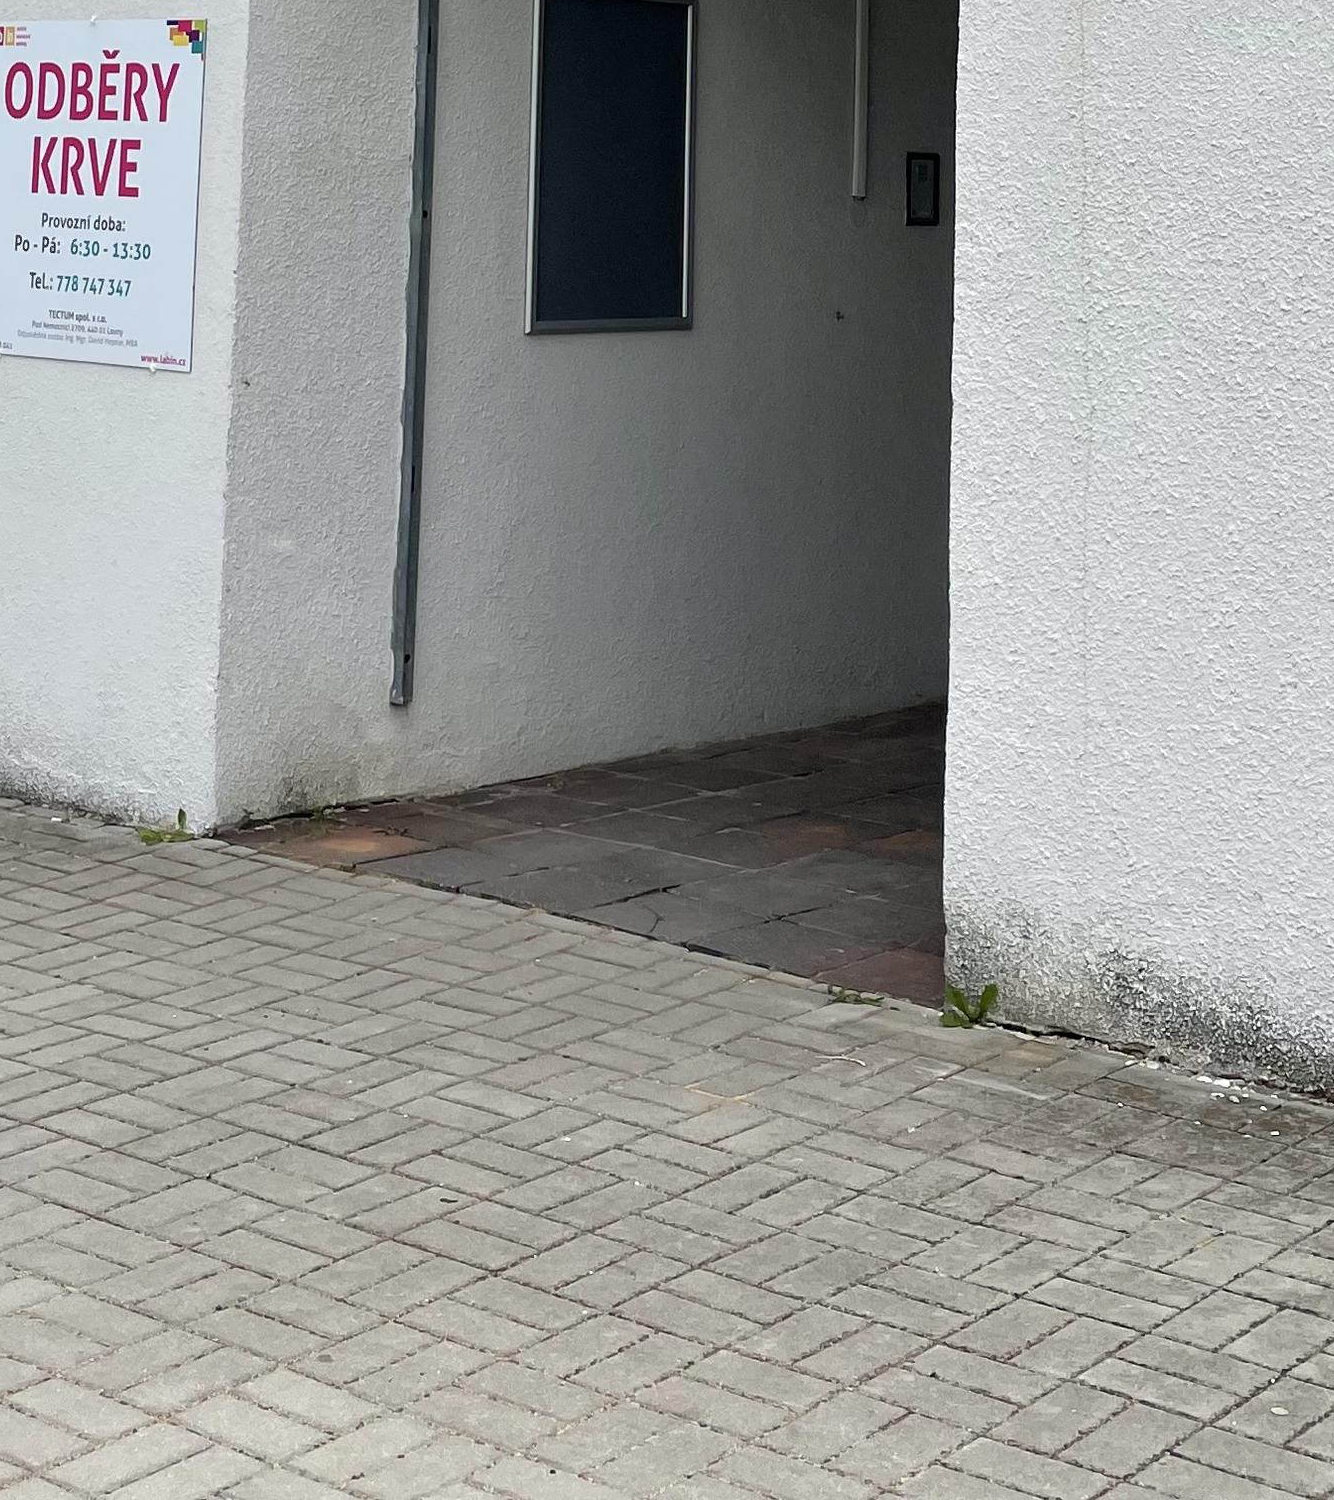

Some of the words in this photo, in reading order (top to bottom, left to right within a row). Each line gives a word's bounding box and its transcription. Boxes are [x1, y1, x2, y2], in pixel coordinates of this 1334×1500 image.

[5, 50, 180, 122] ODBĚRY
[31, 136, 142, 197] KRVE
[42, 212, 91, 230] Provozní
[93, 215, 126, 232] doba:
[14, 234, 30, 252] Po
[42, 236, 61, 254] Pá:
[70, 238, 100, 257] 6:30
[112, 242, 151, 260] 13:30
[29, 271, 53, 290] Tel.:
[57, 275, 79, 292] 778
[82, 277, 105, 295] 747
[108, 279, 131, 297] 347
[49, 309, 75, 320] TECTUM
